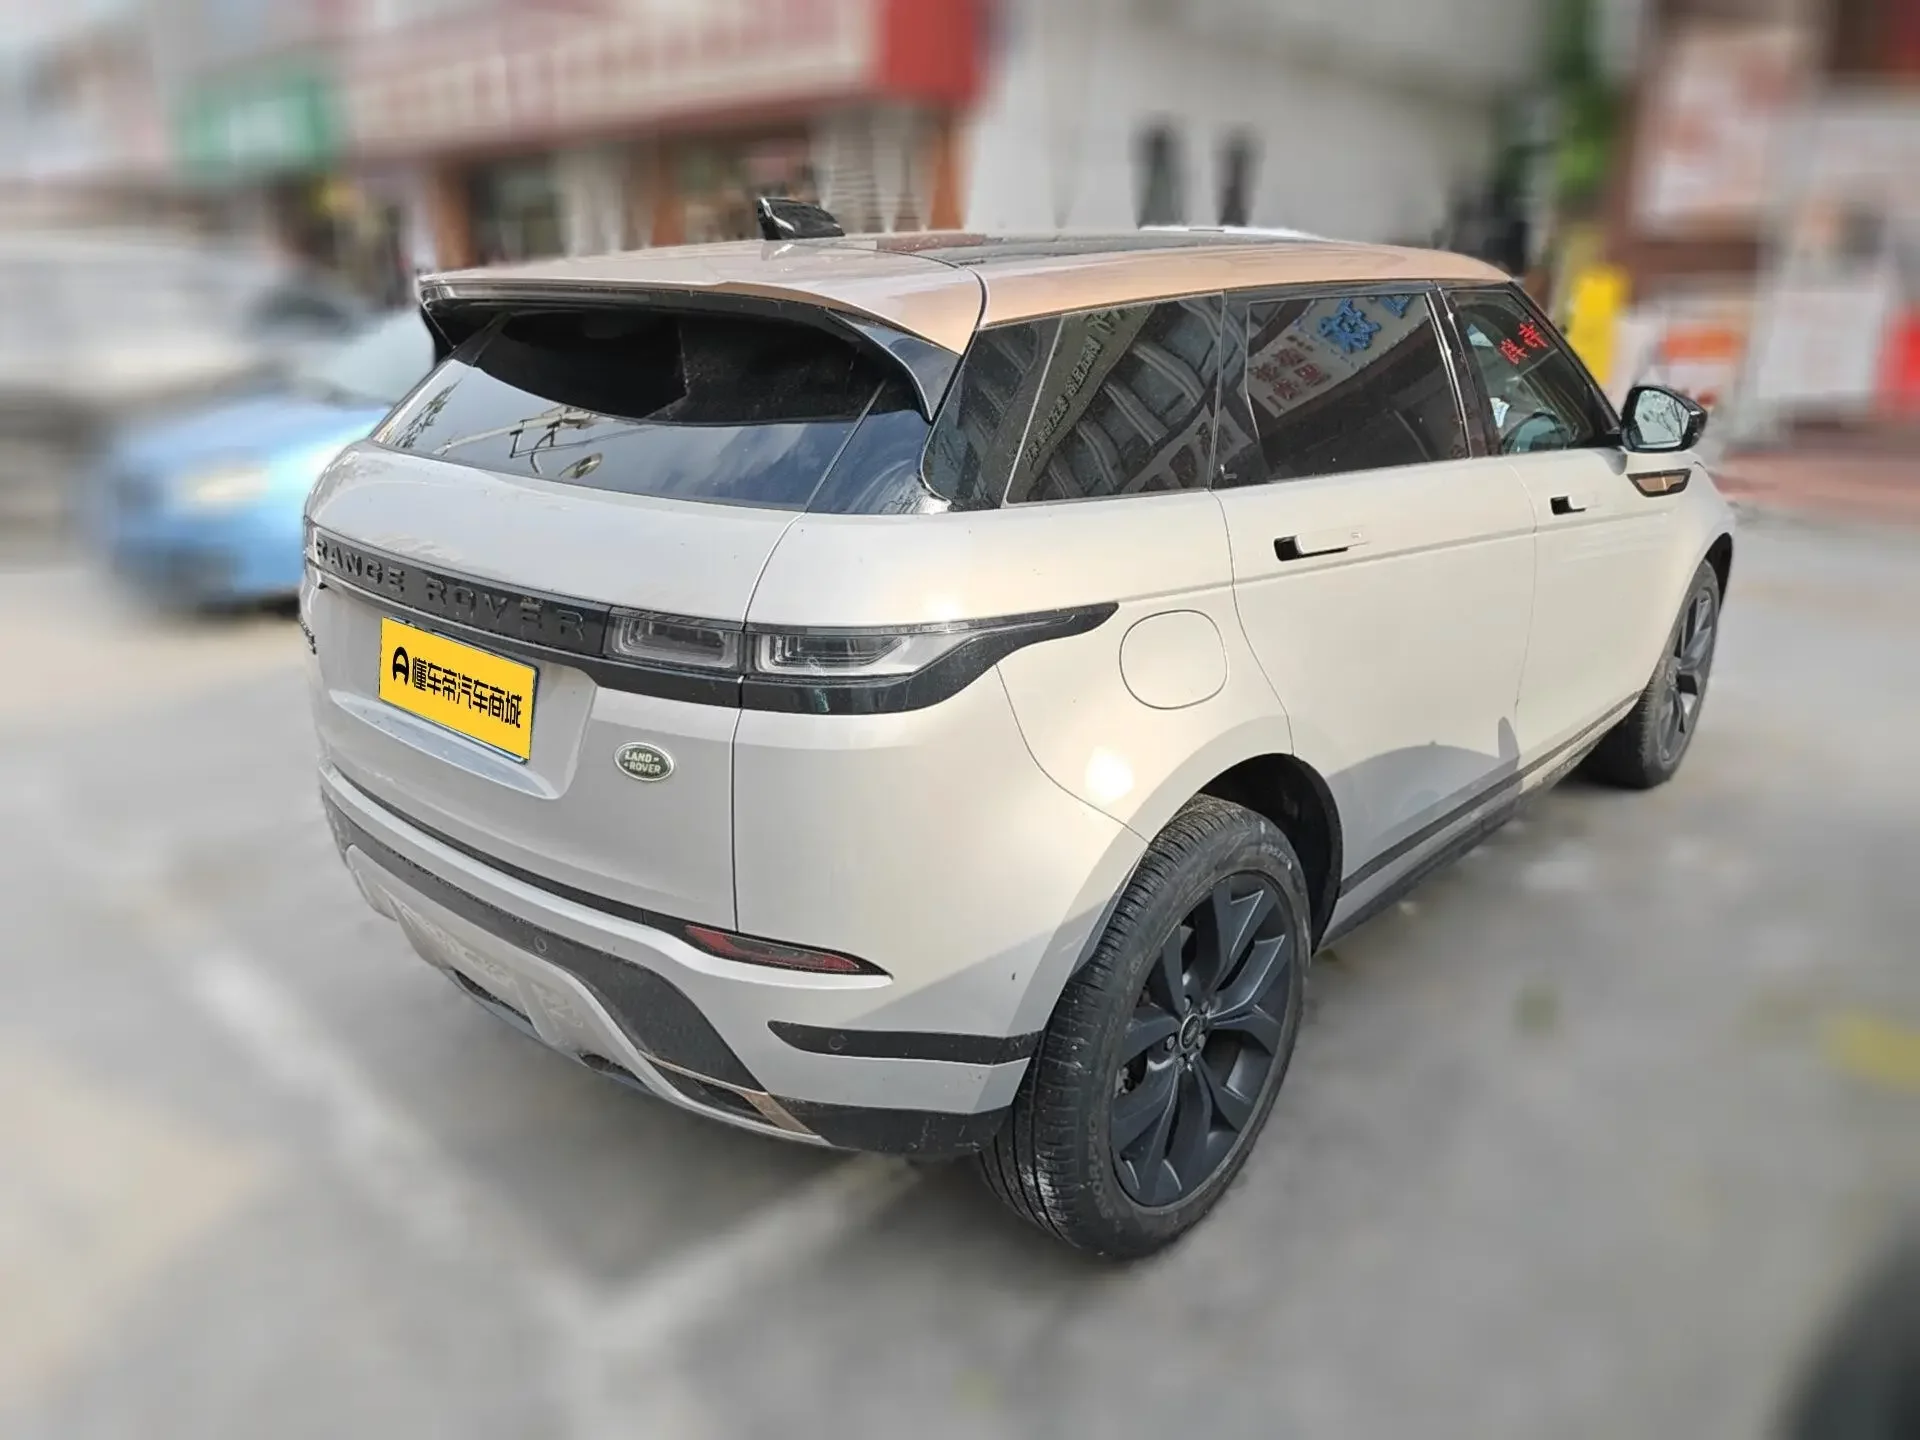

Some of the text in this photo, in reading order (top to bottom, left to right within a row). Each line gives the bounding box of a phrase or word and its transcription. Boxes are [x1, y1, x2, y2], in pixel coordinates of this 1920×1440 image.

[316, 540, 584, 641] RANGE ROVER
[624, 750, 652, 763] LAND
[629, 761, 661, 774] ROVER
